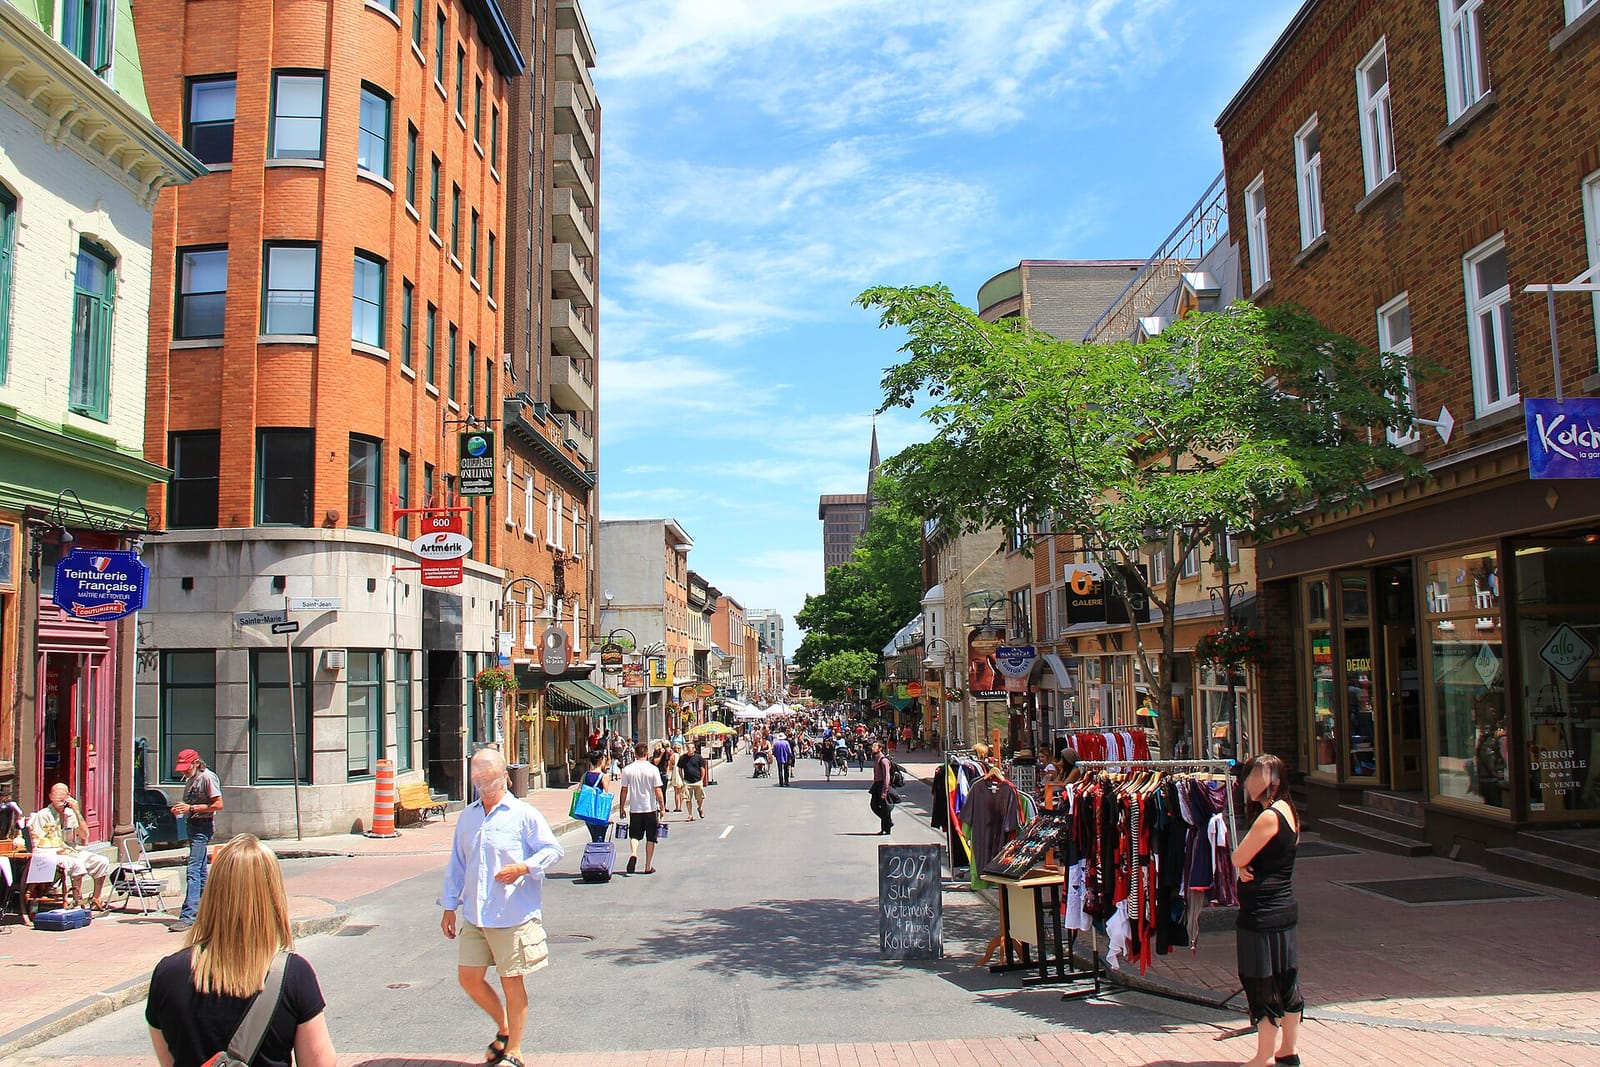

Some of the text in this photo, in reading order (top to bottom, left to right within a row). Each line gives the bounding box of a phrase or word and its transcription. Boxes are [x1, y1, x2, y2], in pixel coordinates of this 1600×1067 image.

[461, 468, 493, 479] O'SULLIVAN
[433, 518, 450, 527] 600
[420, 542, 462, 552] Artmérik
[64, 568, 127, 581] Teinturerie
[78, 580, 137, 593] Française
[77, 591, 130, 600] MAÎTRE NETTOYEUR
[1072, 599, 1103, 607] GALERIE
[239, 616, 282, 625] Sainte-Marie
[1551, 632, 1575, 656] allo
[1346, 658, 1371, 671] DETOX
[1540, 750, 1575, 759] SIROP
[1554, 780, 1582, 788] VENTE
[1554, 788, 1566, 796] ICI
[886, 855, 927, 880] 20%
